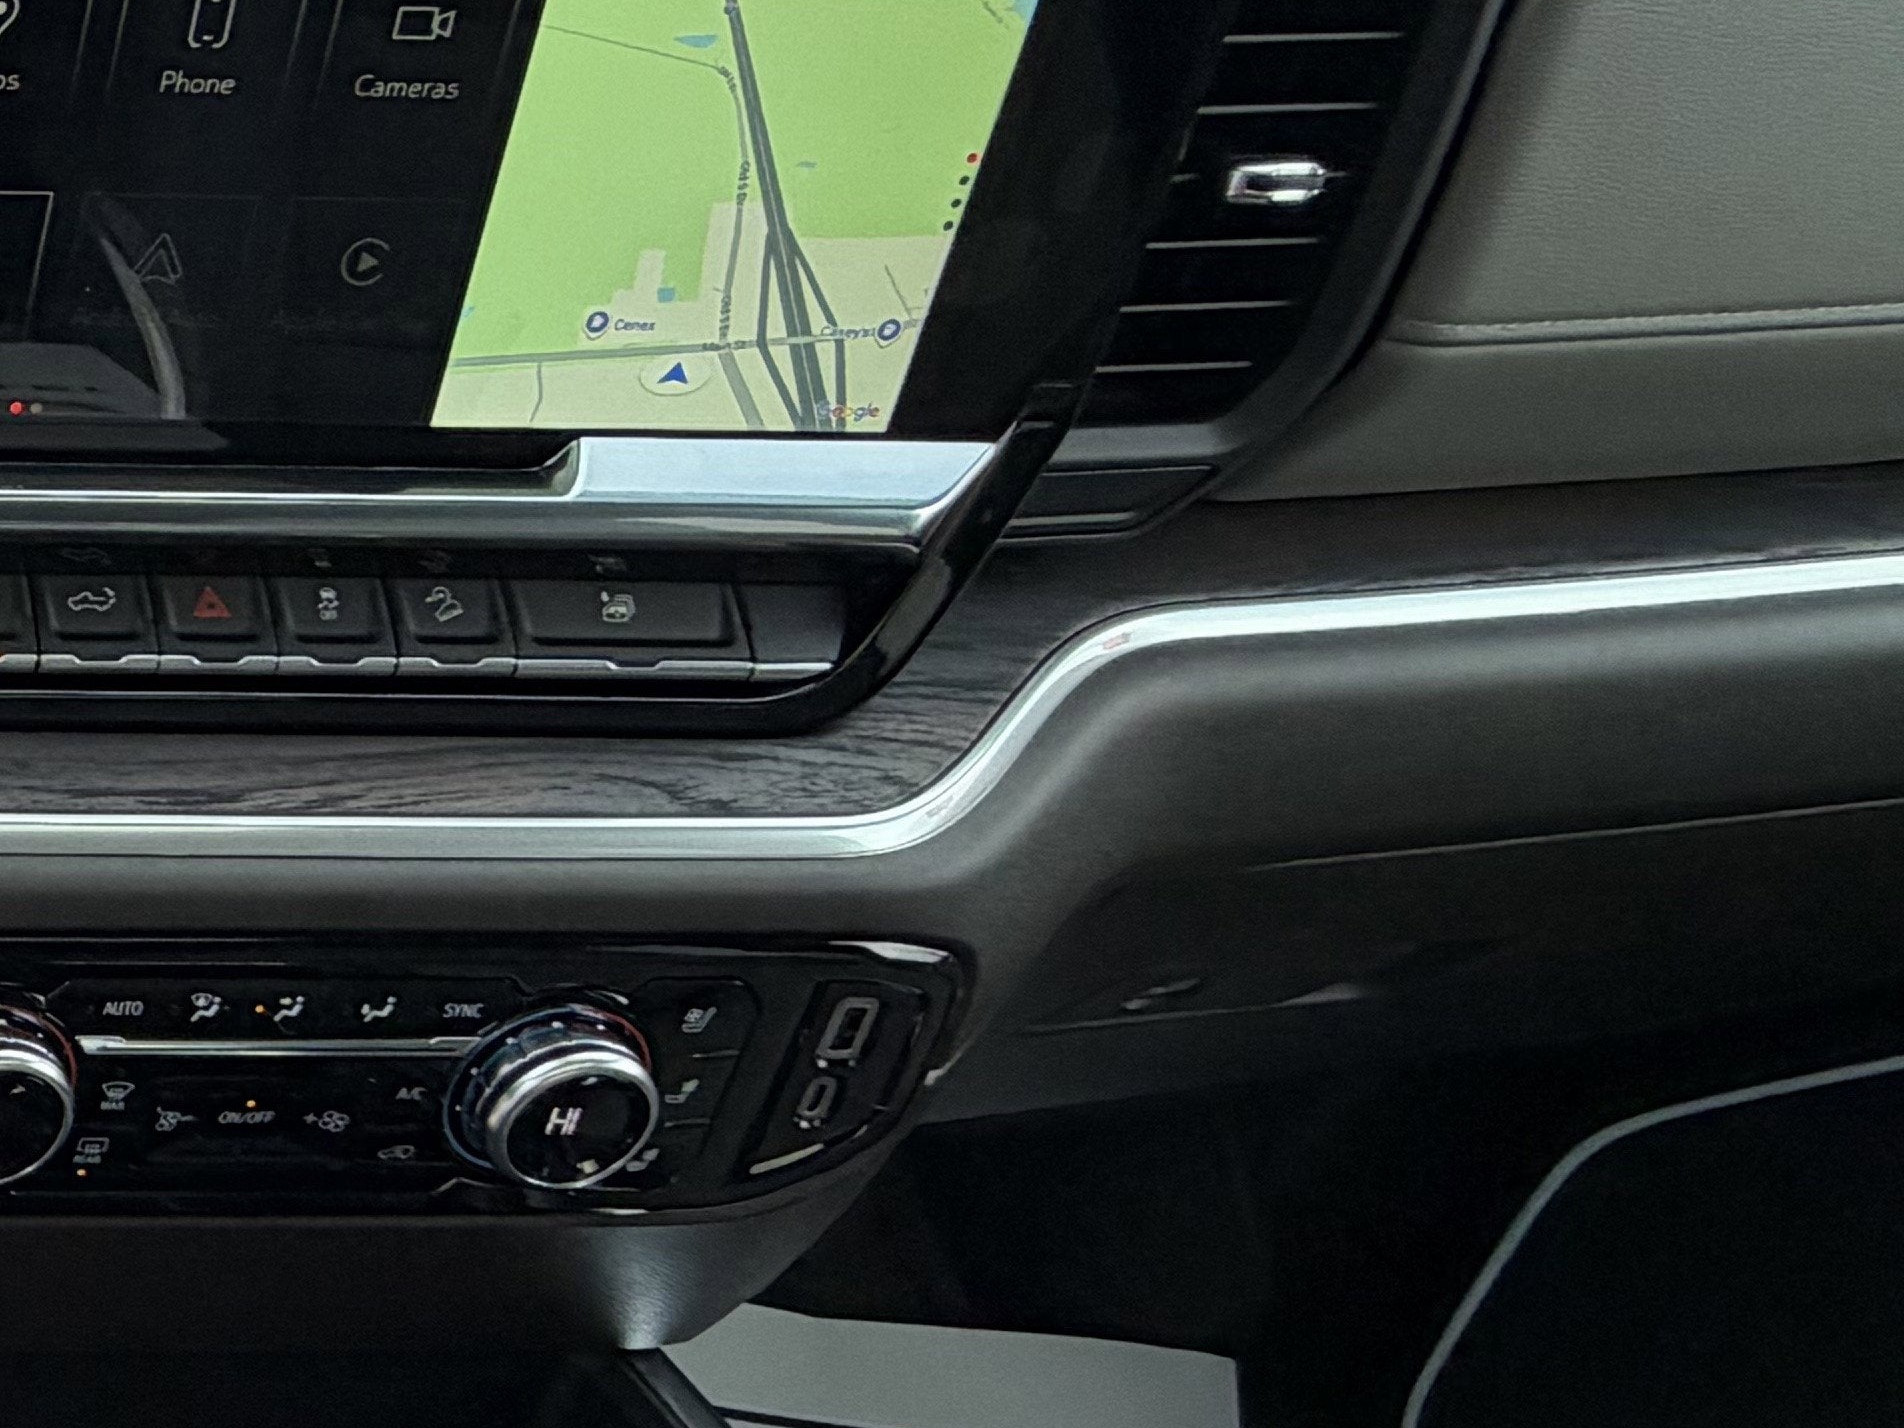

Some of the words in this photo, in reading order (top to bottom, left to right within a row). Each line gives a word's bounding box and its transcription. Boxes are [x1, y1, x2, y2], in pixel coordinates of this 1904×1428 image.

[158, 70, 236, 95] Phone
[354, 75, 460, 101] Cameras
[816, 401, 880, 422] Google
[102, 1000, 144, 1016] AUTO
[443, 1003, 485, 1018] SYNC
[218, 1110, 276, 1124] ON/OFF
[544, 1107, 584, 1136] HI
